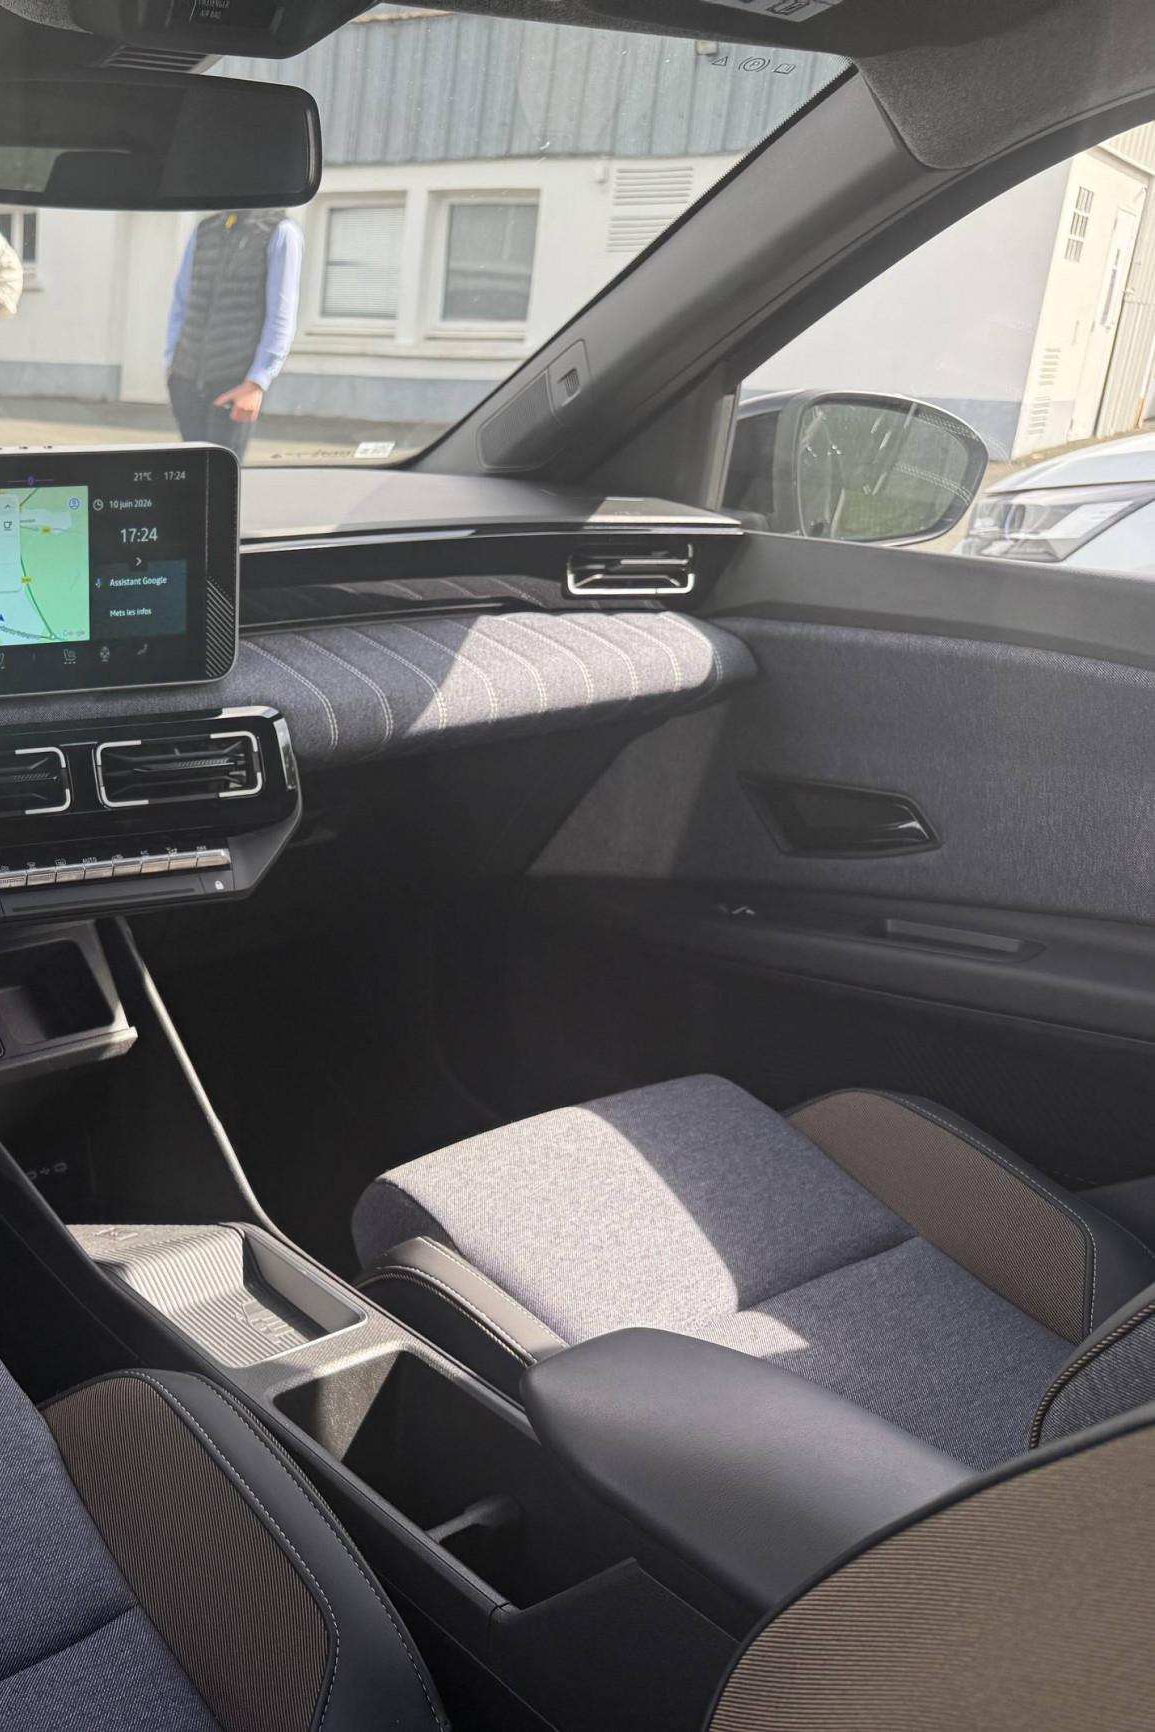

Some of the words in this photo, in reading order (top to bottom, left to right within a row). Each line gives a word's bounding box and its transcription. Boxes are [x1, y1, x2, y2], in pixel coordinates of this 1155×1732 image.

[164, 471, 186, 480] 17:24
[109, 500, 119, 508] 10
[119, 500, 133, 510] juin
[134, 499, 152, 508] 2026
[120, 527, 158, 543] 17:24
[109, 578, 142, 587] Assistant
[142, 576, 167, 586] Google
[109, 609, 126, 617] Mets
[126, 608, 136, 616] les
[136, 608, 152, 616] infos
